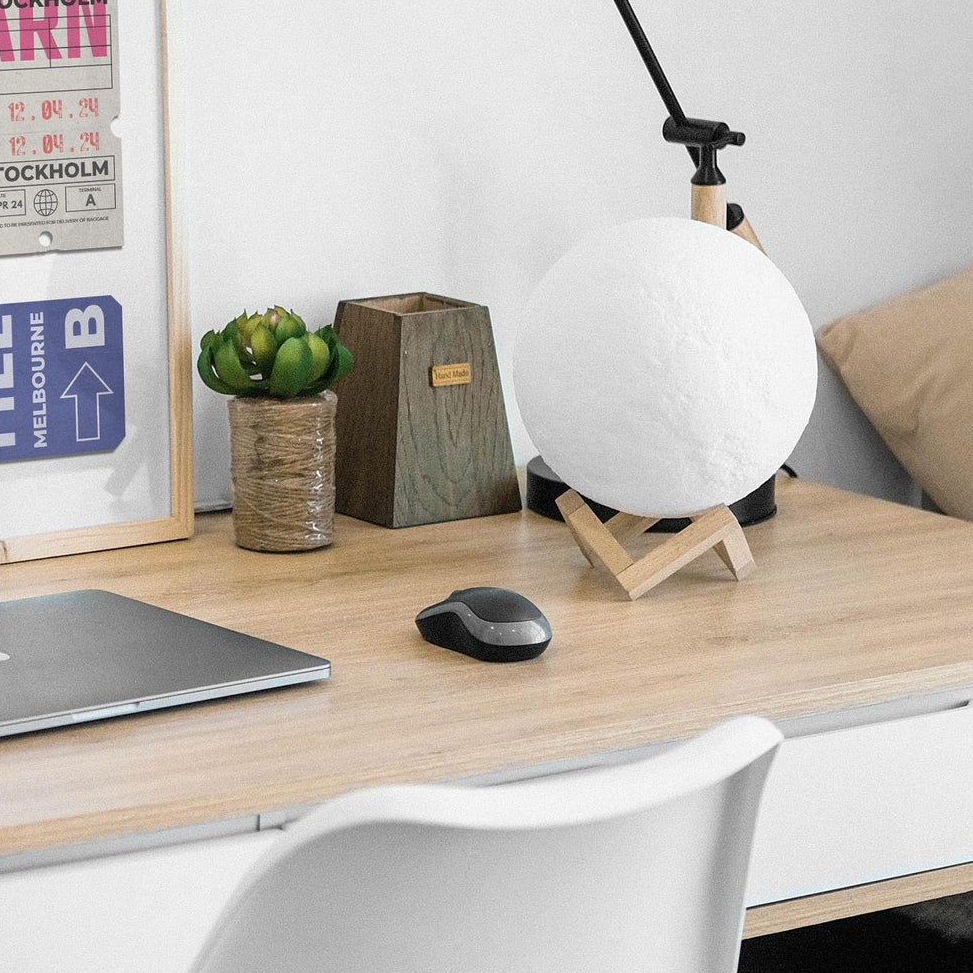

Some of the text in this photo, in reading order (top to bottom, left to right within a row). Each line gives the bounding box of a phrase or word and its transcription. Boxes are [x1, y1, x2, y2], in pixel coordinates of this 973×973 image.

[12, 200, 23, 209] 24
[86, 194, 96, 206] A
[64, 304, 105, 348] B
[30, 311, 48, 448] MELBOURNE
